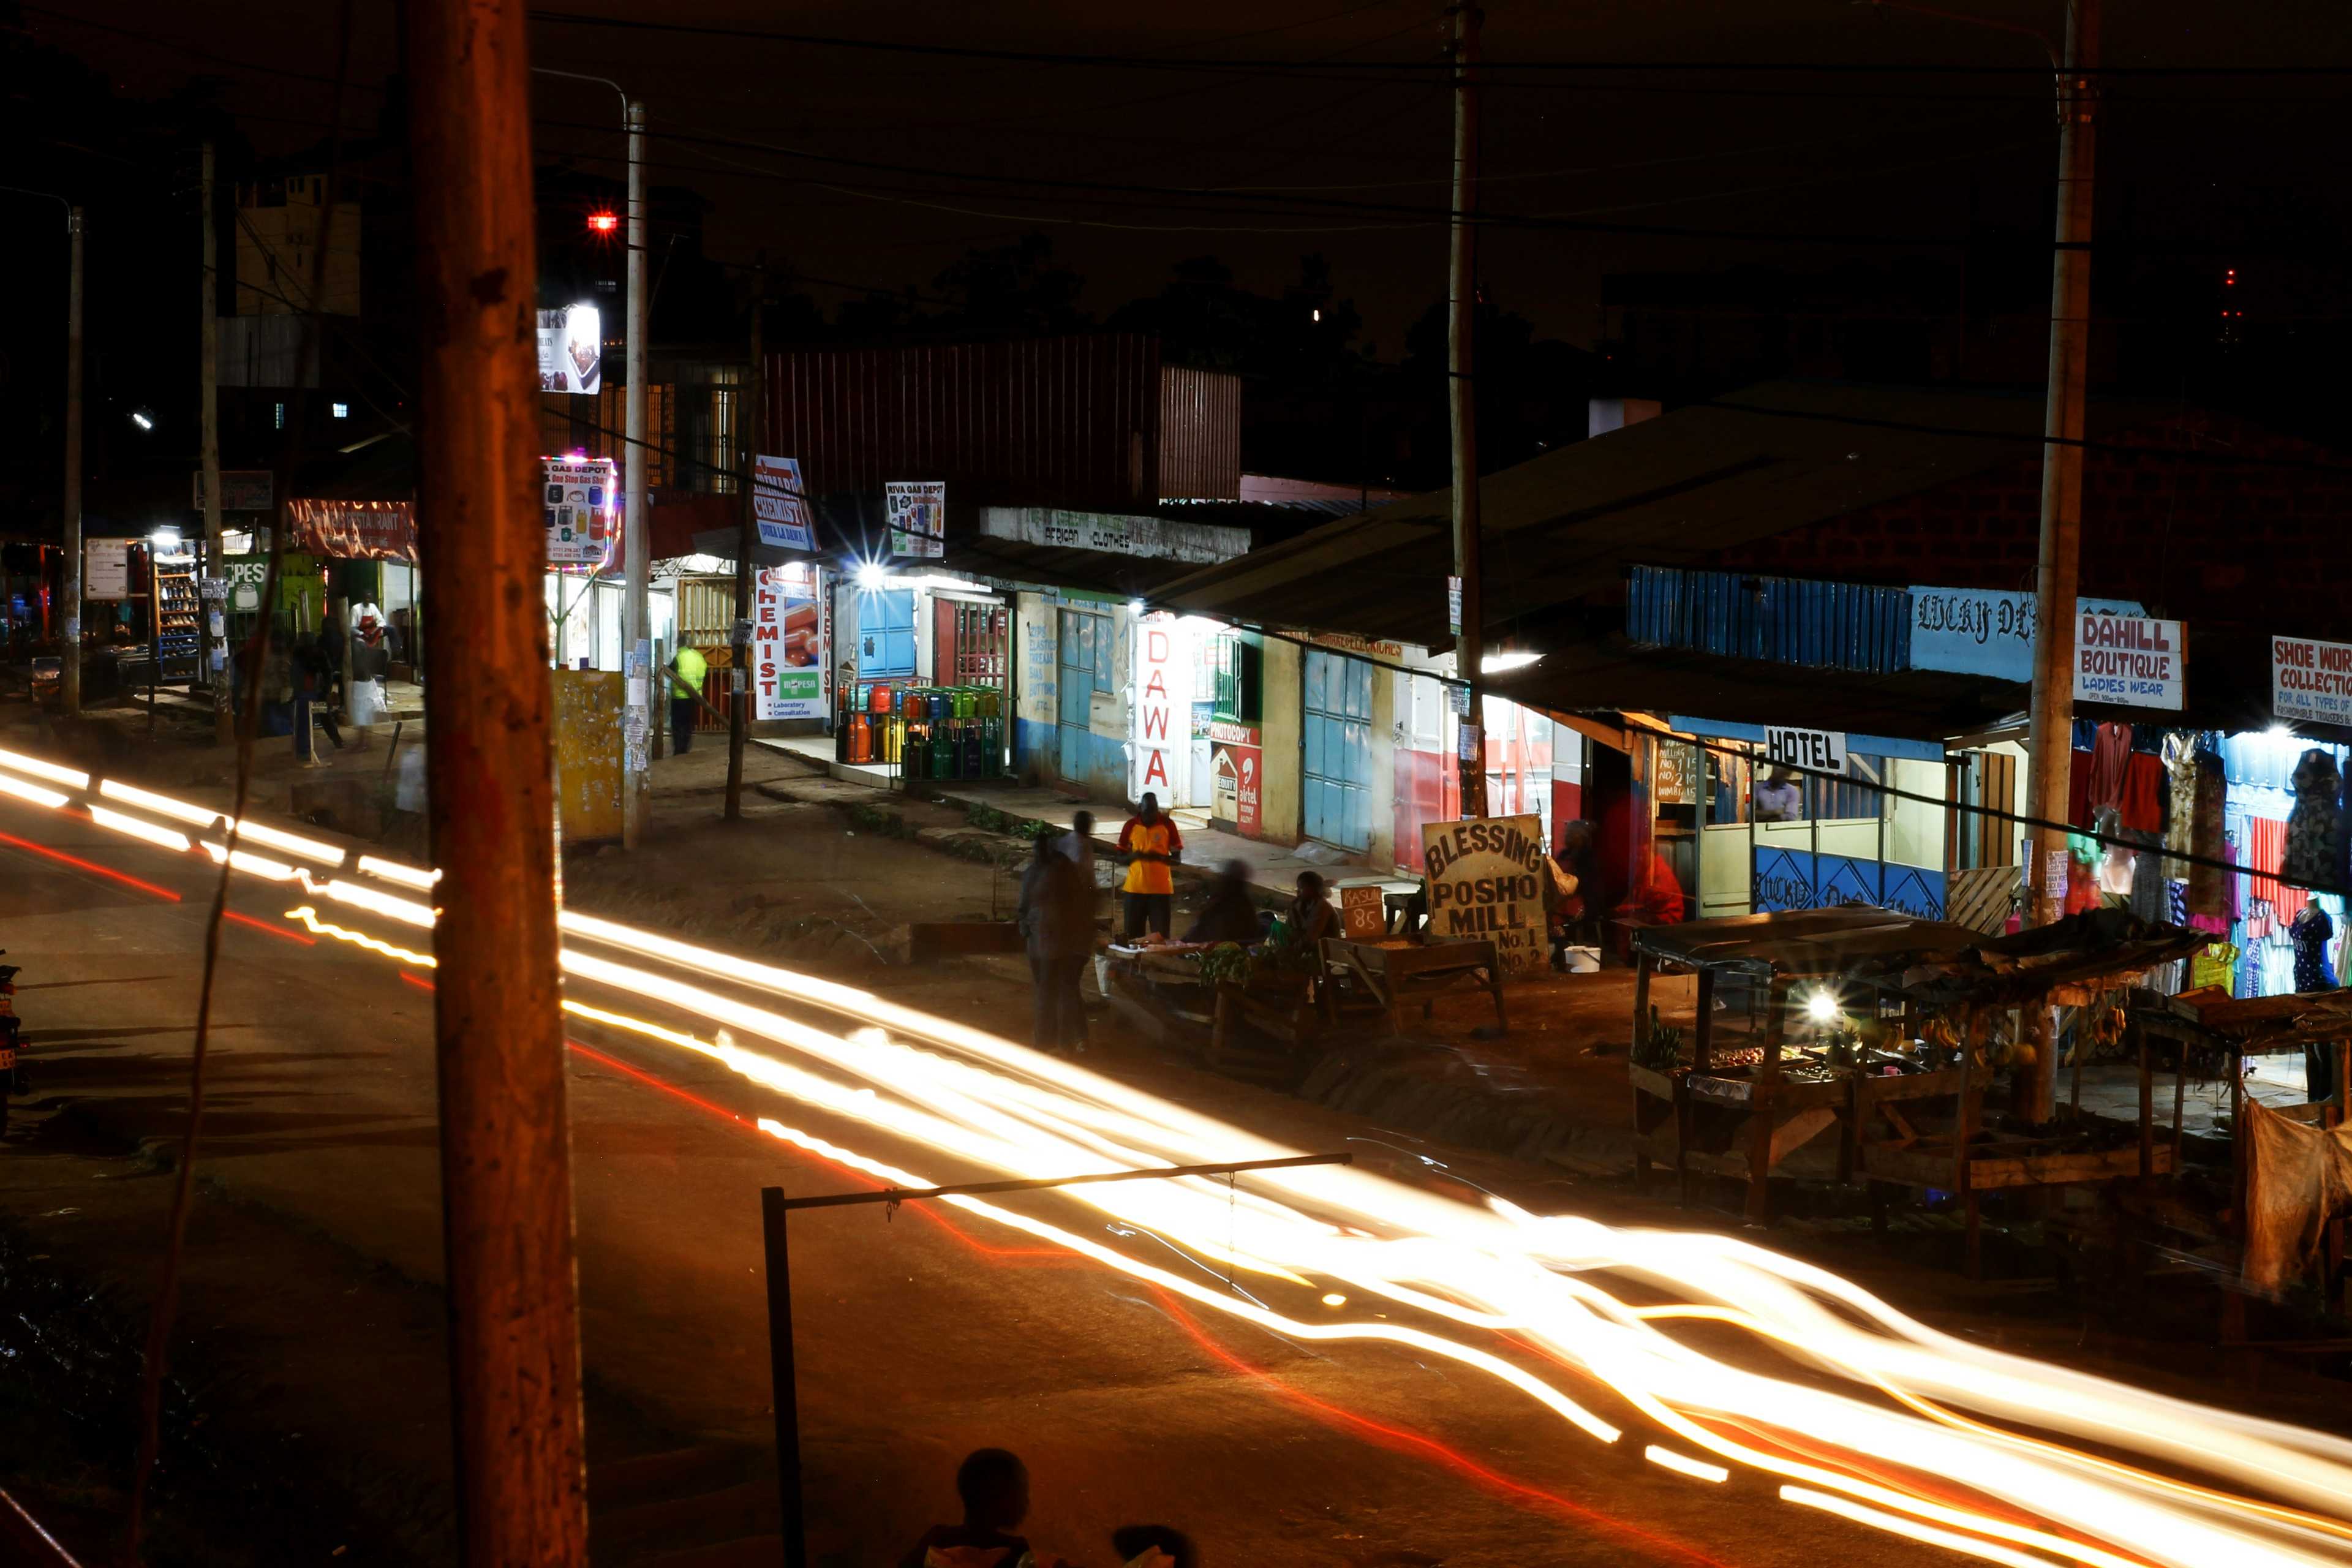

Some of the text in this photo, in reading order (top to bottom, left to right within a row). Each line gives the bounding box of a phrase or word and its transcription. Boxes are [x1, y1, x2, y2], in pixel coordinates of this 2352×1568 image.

[565, 475, 579, 484] Stop
[924, 485, 943, 494] DEPOT
[755, 496, 801, 524] CHEMIST
[1046, 527, 1129, 548] AFRICAN CLOTHES
[2082, 617, 2169, 652] DAHILL
[2081, 650, 2169, 680] BOUTIQUE
[2274, 641, 2352, 673] SHOE WOR
[2083, 676, 2163, 697] LADIES WEAR
[2280, 668, 2352, 696] COLLECTIO
[1144, 631, 1169, 787] DAWA
[2278, 692, 2350, 712] FOR ALL TYPES OF
[2315, 710, 2344, 724] TROUSERS
[1210, 723, 1251, 743] PHOTOCOPY
[1768, 729, 1840, 769] HOTEL
[1218, 778, 1236, 791] EQUITY
[1675, 772, 1682, 786] 2
[1240, 785, 1257, 804] airtel
[1425, 824, 1541, 880] BLESSING
[1433, 875, 1537, 908] POSHO
[1354, 908, 1375, 929] 85
[1449, 904, 1526, 934] MILL
[1529, 929, 1536, 947] 1
